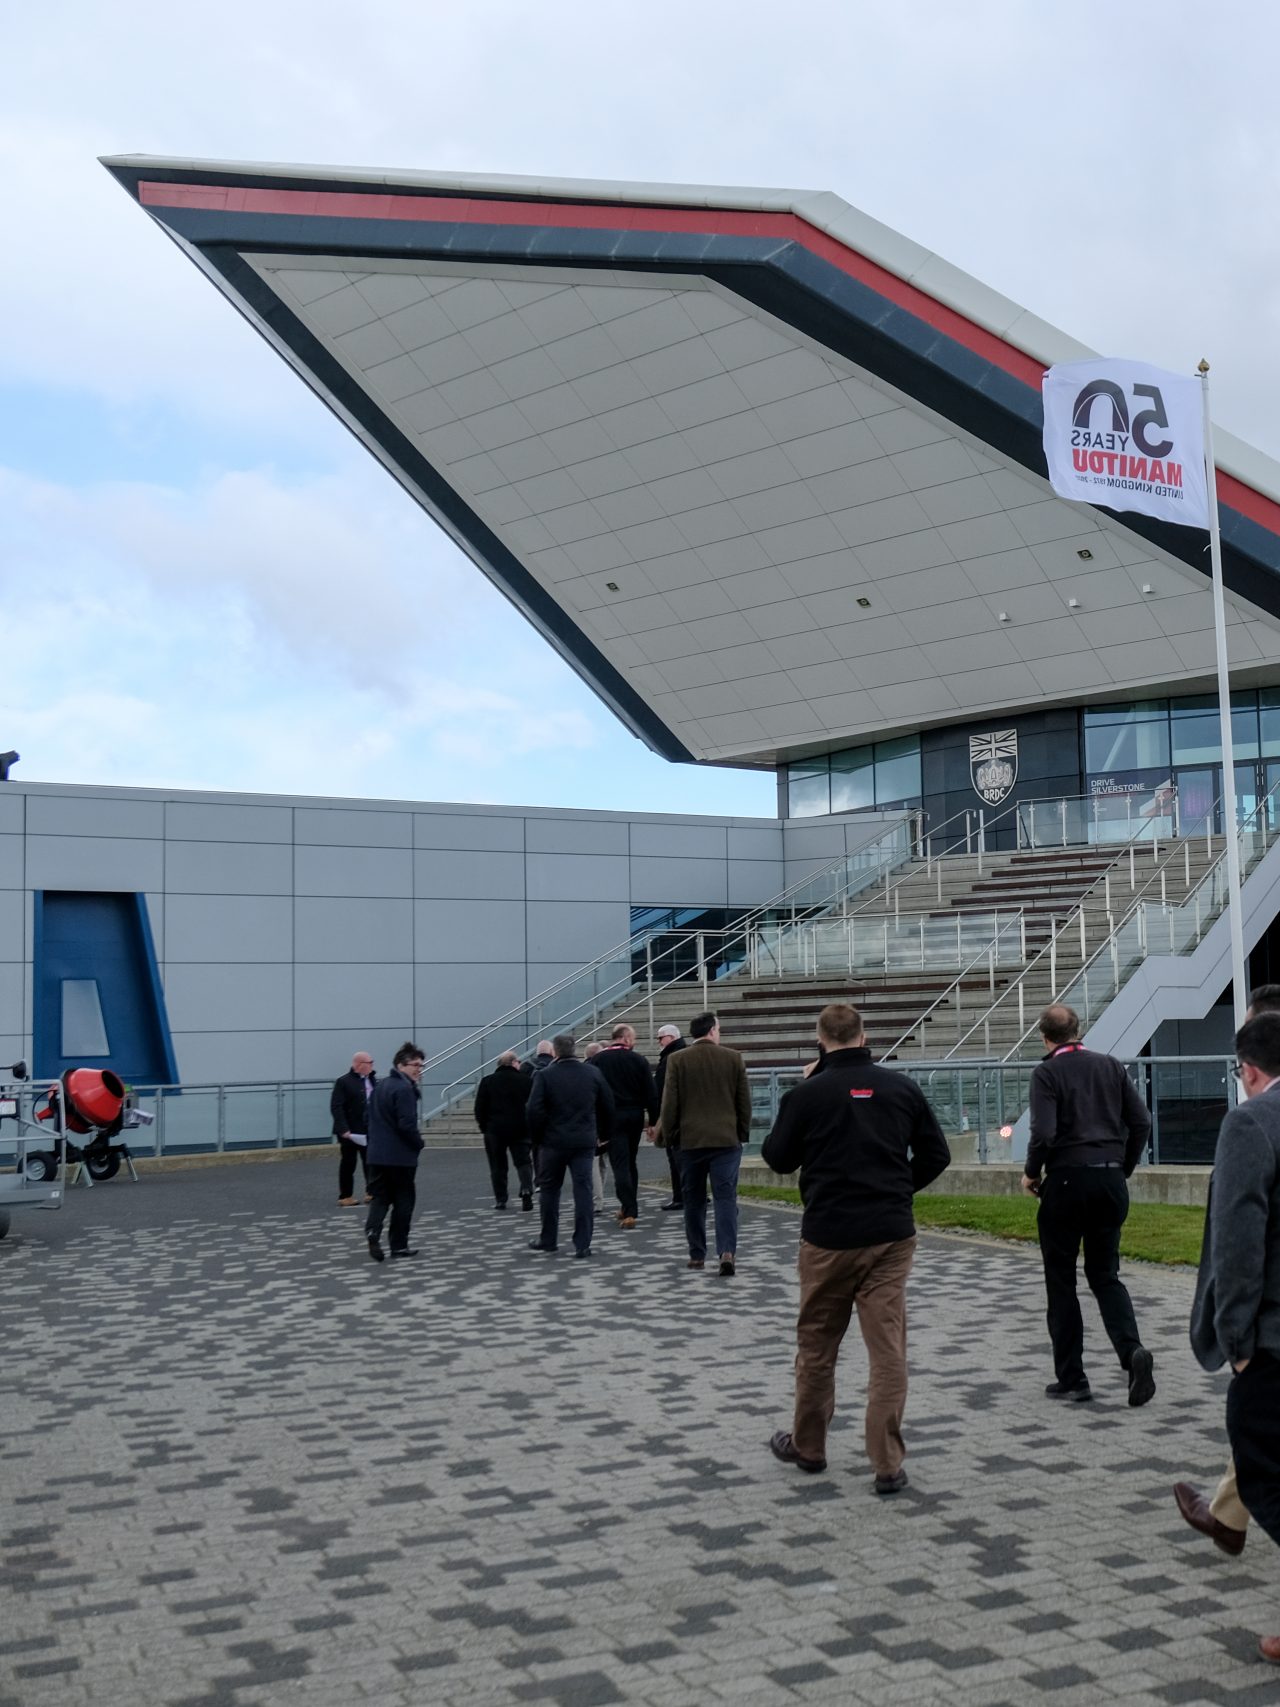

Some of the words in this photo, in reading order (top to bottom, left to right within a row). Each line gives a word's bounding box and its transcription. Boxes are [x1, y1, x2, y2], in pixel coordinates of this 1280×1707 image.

[1091, 778, 1115, 788] DRIVE
[1091, 782, 1145, 795] SILVERSTONE
[983, 787, 1005, 801] BRDC
